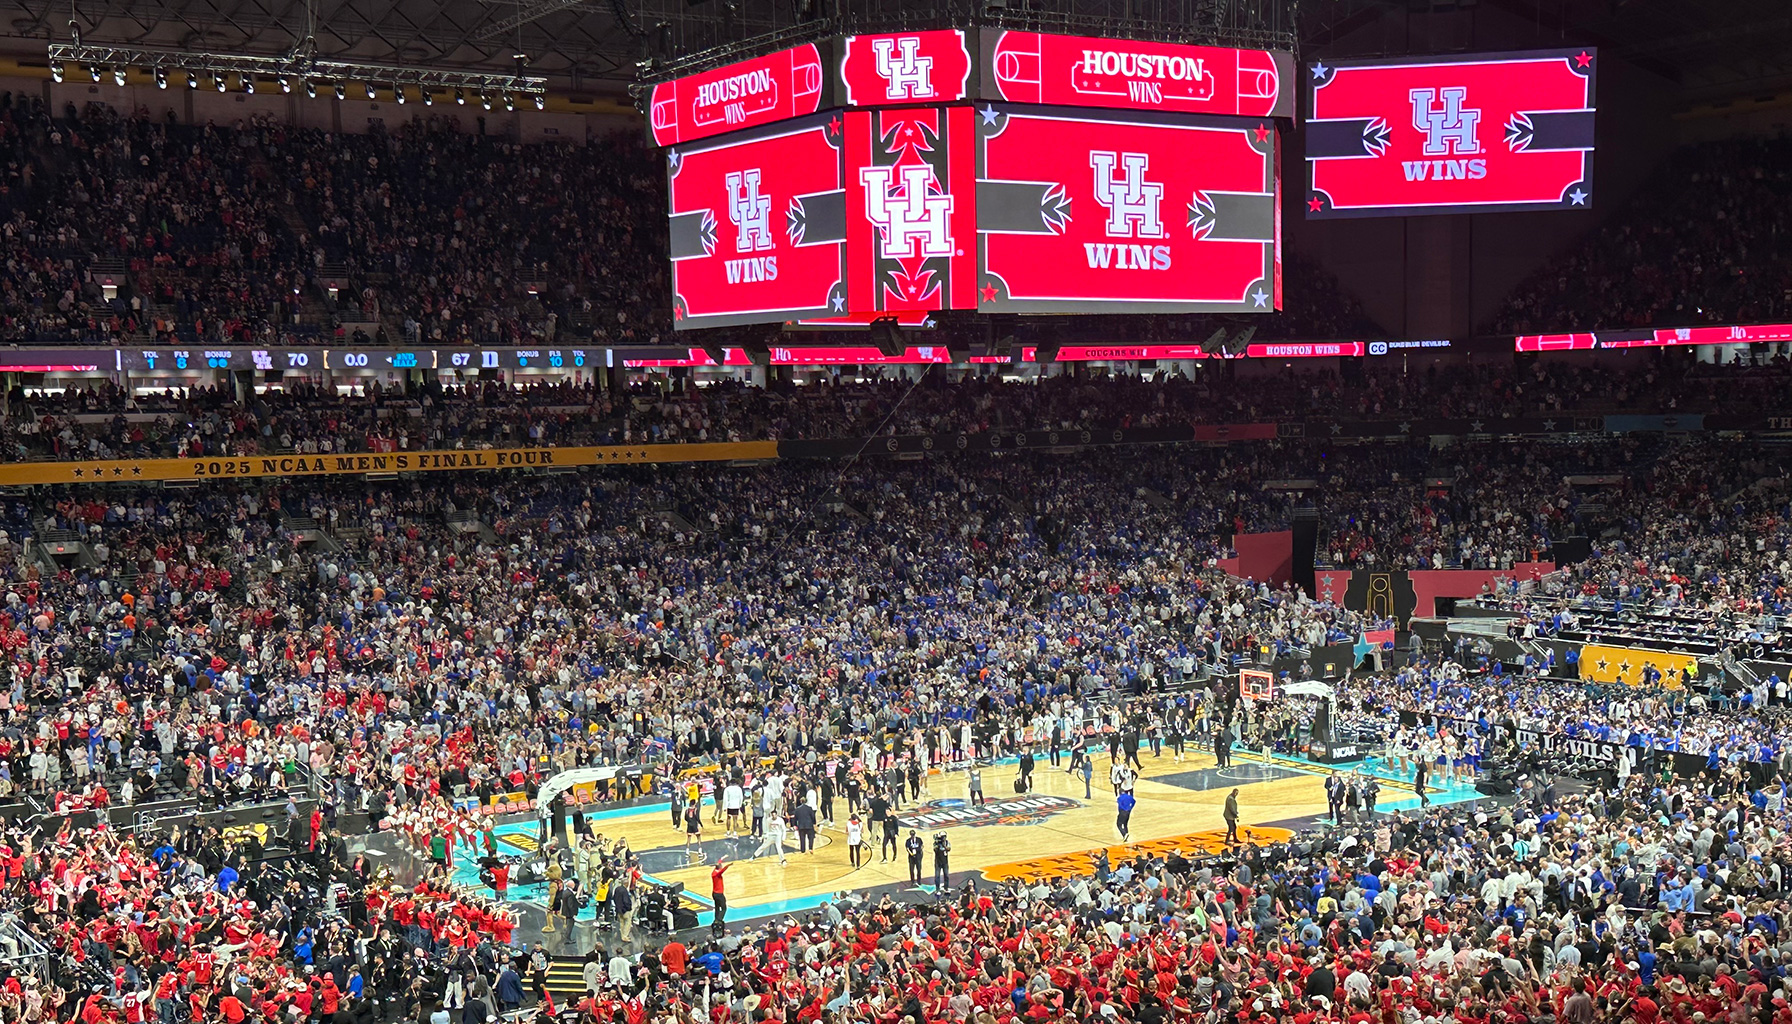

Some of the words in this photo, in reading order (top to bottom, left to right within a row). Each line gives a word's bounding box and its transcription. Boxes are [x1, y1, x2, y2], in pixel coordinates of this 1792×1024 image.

[872, 36, 933, 99] UH
[1082, 50, 1204, 81] HOUSTON
[697, 67, 771, 108] HOUSTON
[1127, 80, 1163, 104] WINS
[724, 101, 746, 125] WINS
[1409, 86, 1482, 156] UH
[1401, 158, 1488, 182] WINS
[1089, 150, 1164, 239] UH
[725, 168, 772, 253] UH
[859, 163, 955, 259] UH
[1083, 243, 1172, 271] WINS
[724, 255, 778, 284] WINS
[288, 353, 308, 366] 70
[395, 352, 415, 360] 2ND
[452, 353, 470, 366] 67
[517, 350, 539, 358] BONUS
[1085, 349, 1126, 357] COUGARS
[1266, 345, 1312, 355] HOUSTON
[1315, 345, 1340, 354] WINS
[147, 358, 154, 368] 1
[176, 358, 187, 368] 8
[344, 353, 368, 367] 0.0
[393, 359, 418, 367] HALF
[550, 357, 563, 367] 10
[575, 357, 584, 367] 0
[194, 461, 251, 476] 2025
[262, 457, 327, 473] NCAA
[337, 454, 409, 471] MEN'S
[418, 452, 488, 468] FINAL
[497, 450, 554, 466] FOUR
[1332, 745, 1357, 759] NCAA
[899, 806, 990, 826] FINAL
[981, 796, 1068, 814] FOUR
[126, 998, 136, 1008] 27
